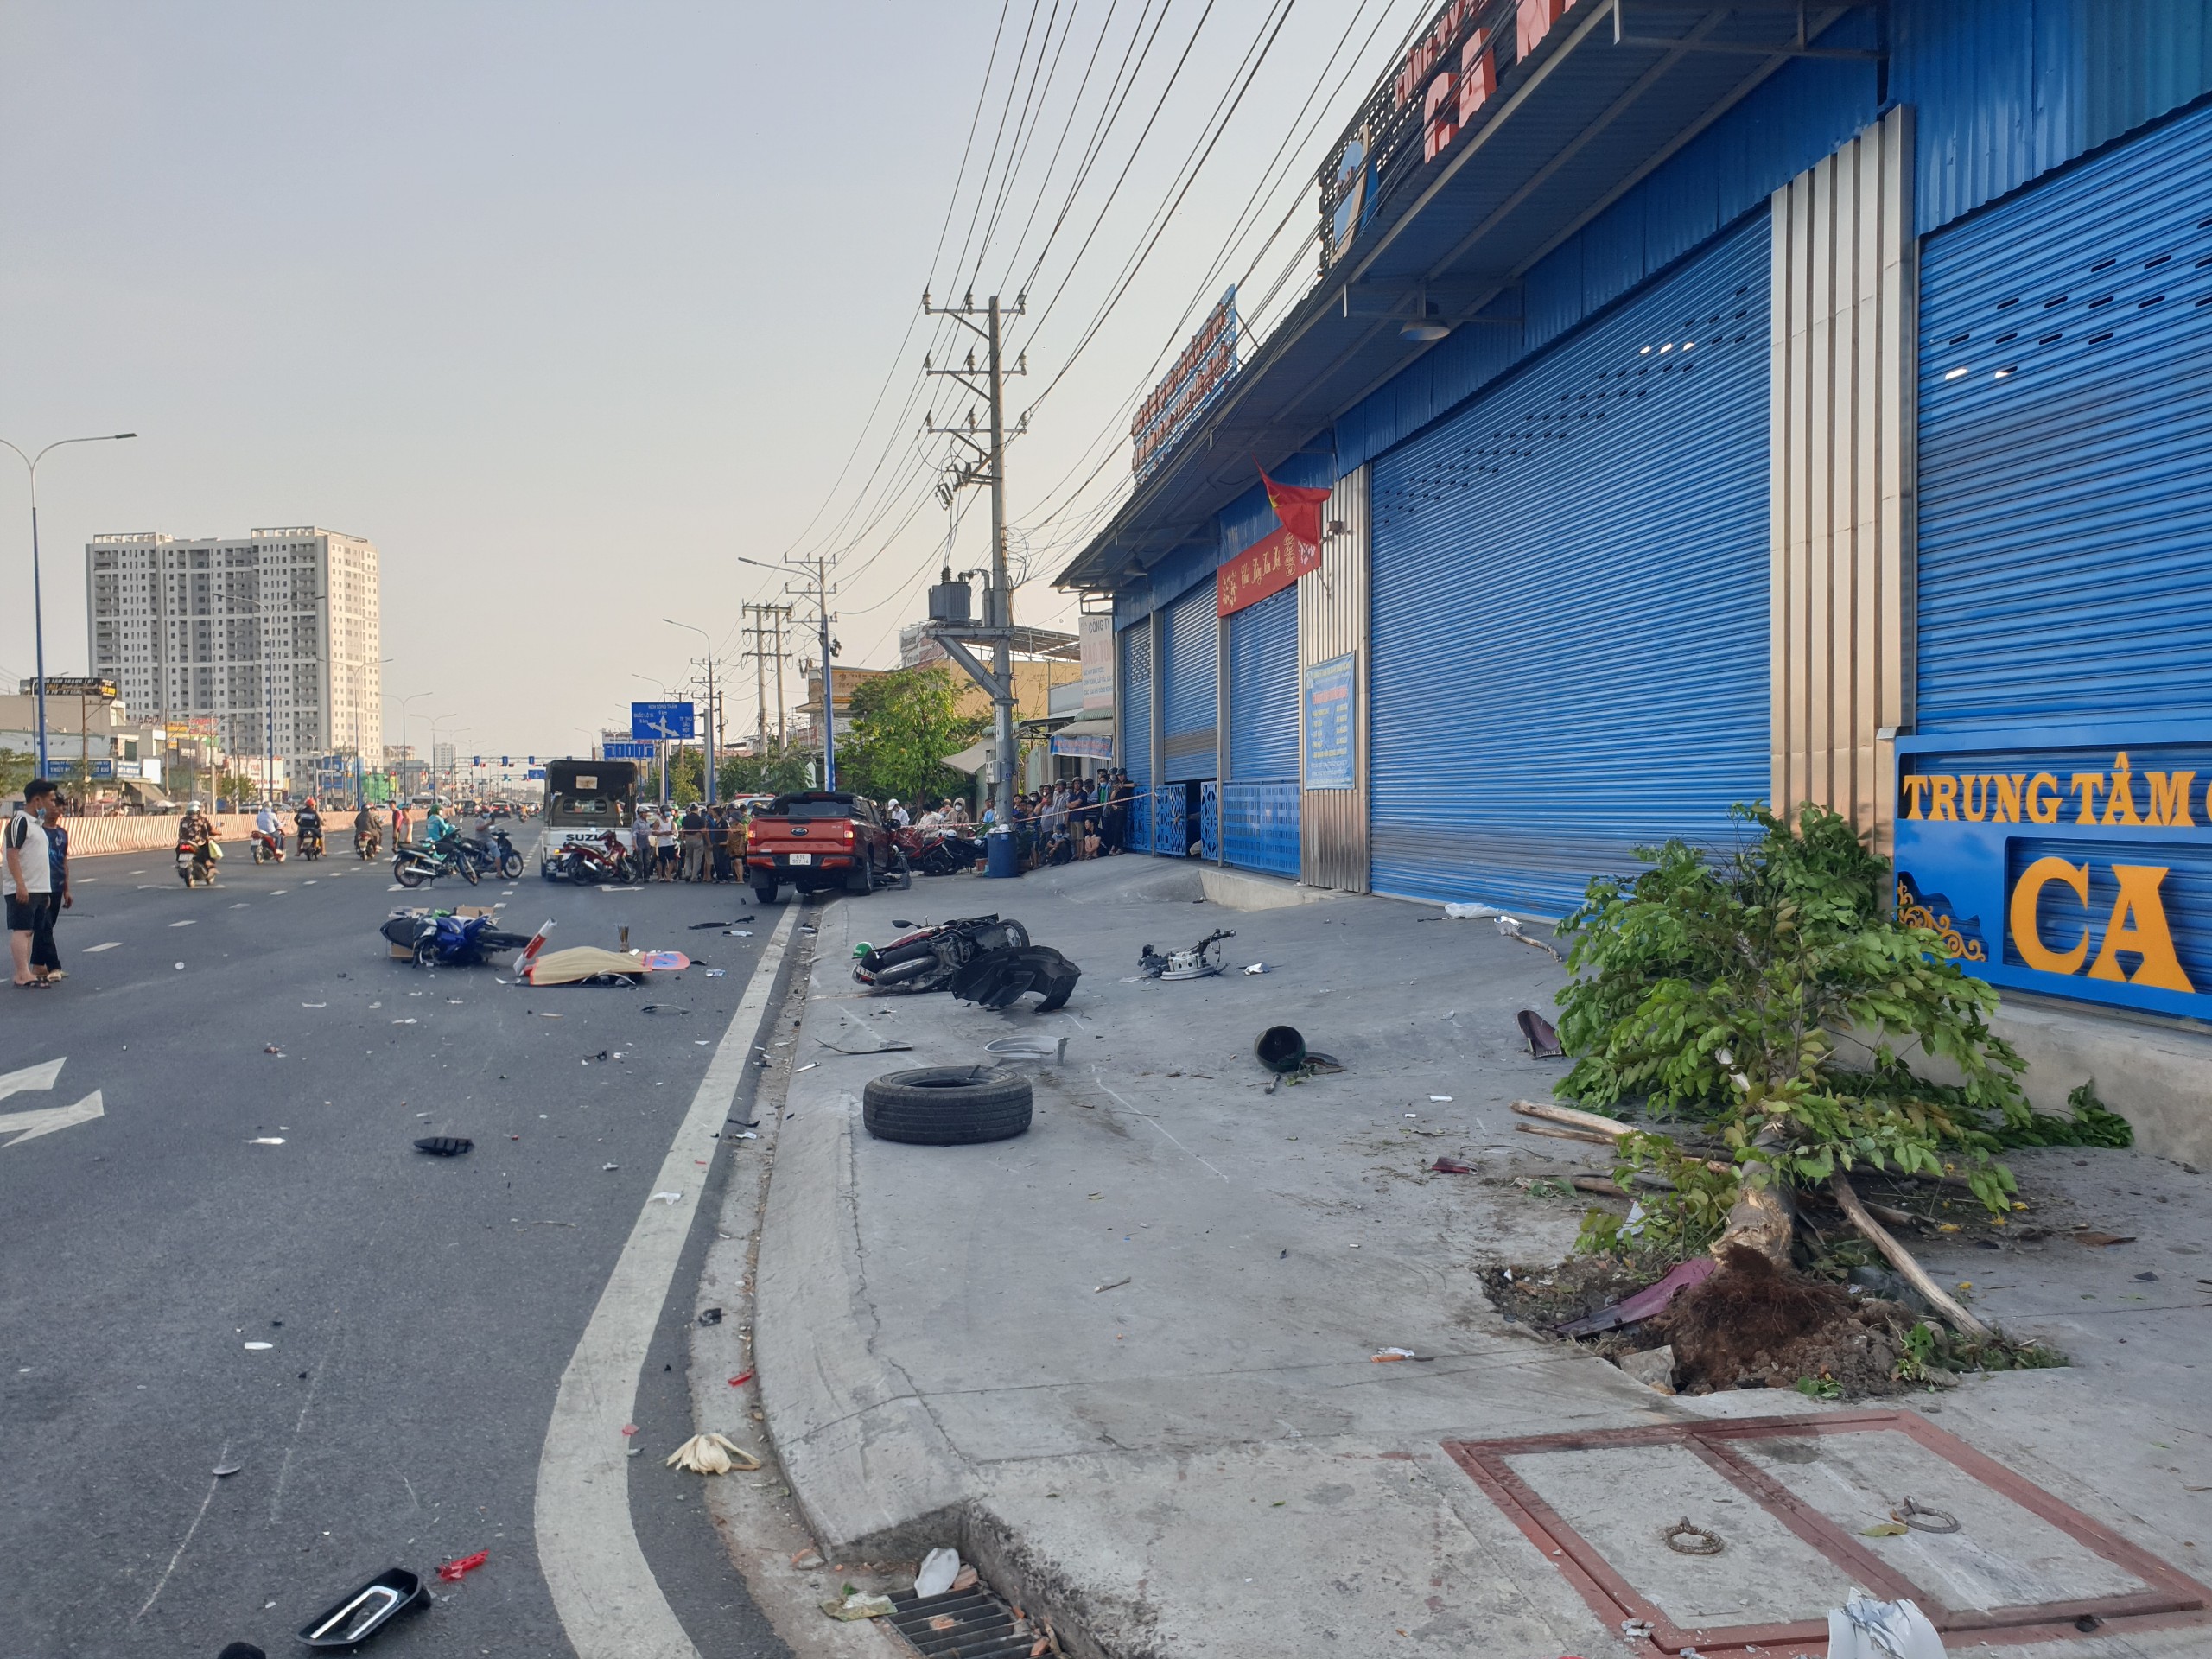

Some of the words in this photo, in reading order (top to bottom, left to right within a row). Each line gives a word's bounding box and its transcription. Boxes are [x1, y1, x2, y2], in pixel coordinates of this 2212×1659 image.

[1394, 36, 1433, 111] CÔNG
[1089, 618, 1104, 634] CÔNG
[1903, 772, 2063, 823] TRUNG
[2070, 751, 2196, 827] TÂM
[2010, 856, 2196, 994] CA
